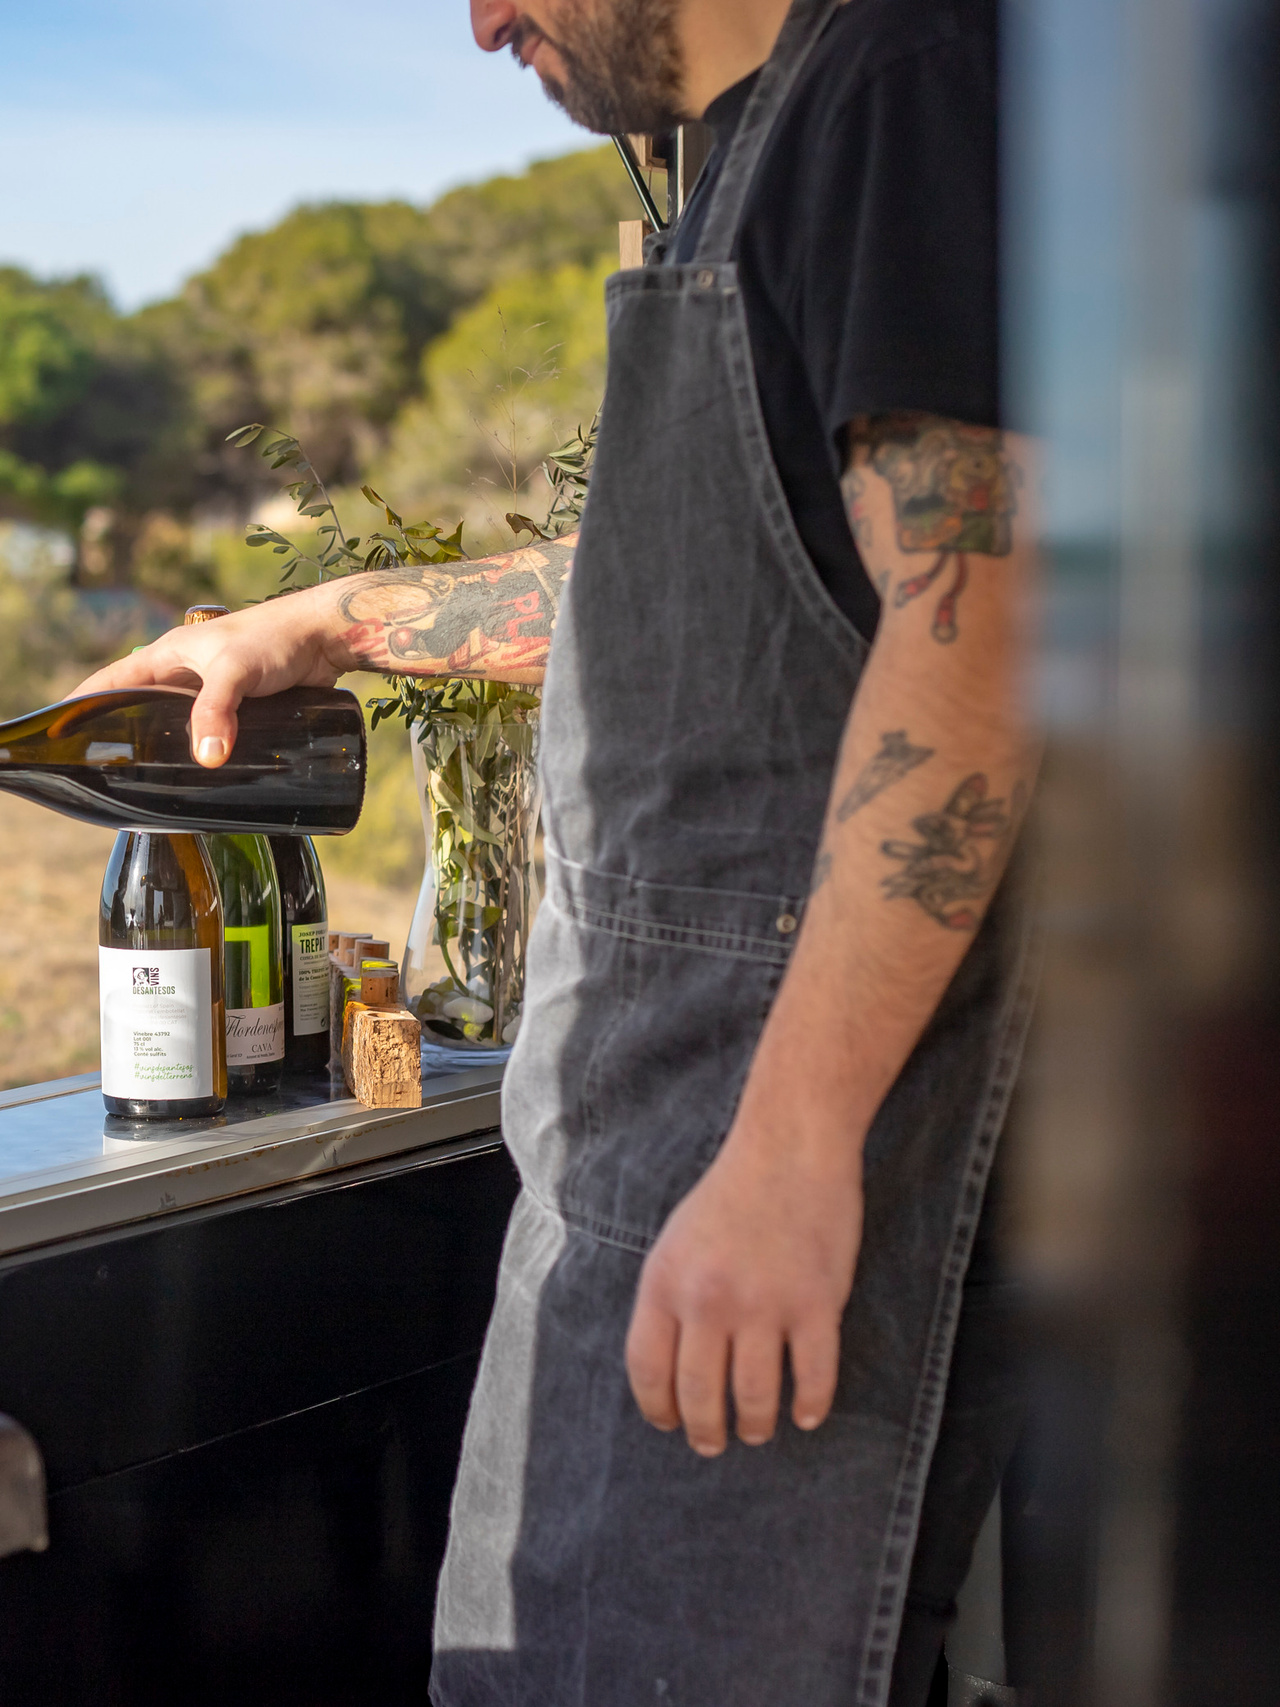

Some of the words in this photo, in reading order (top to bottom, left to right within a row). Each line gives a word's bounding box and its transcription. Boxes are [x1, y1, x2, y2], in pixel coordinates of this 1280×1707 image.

[300, 937, 325, 954] TREPAT
[150, 968, 160, 986] VINS
[132, 986, 176, 995] DESANTESOS
[251, 1043, 272, 1053] CAVA
